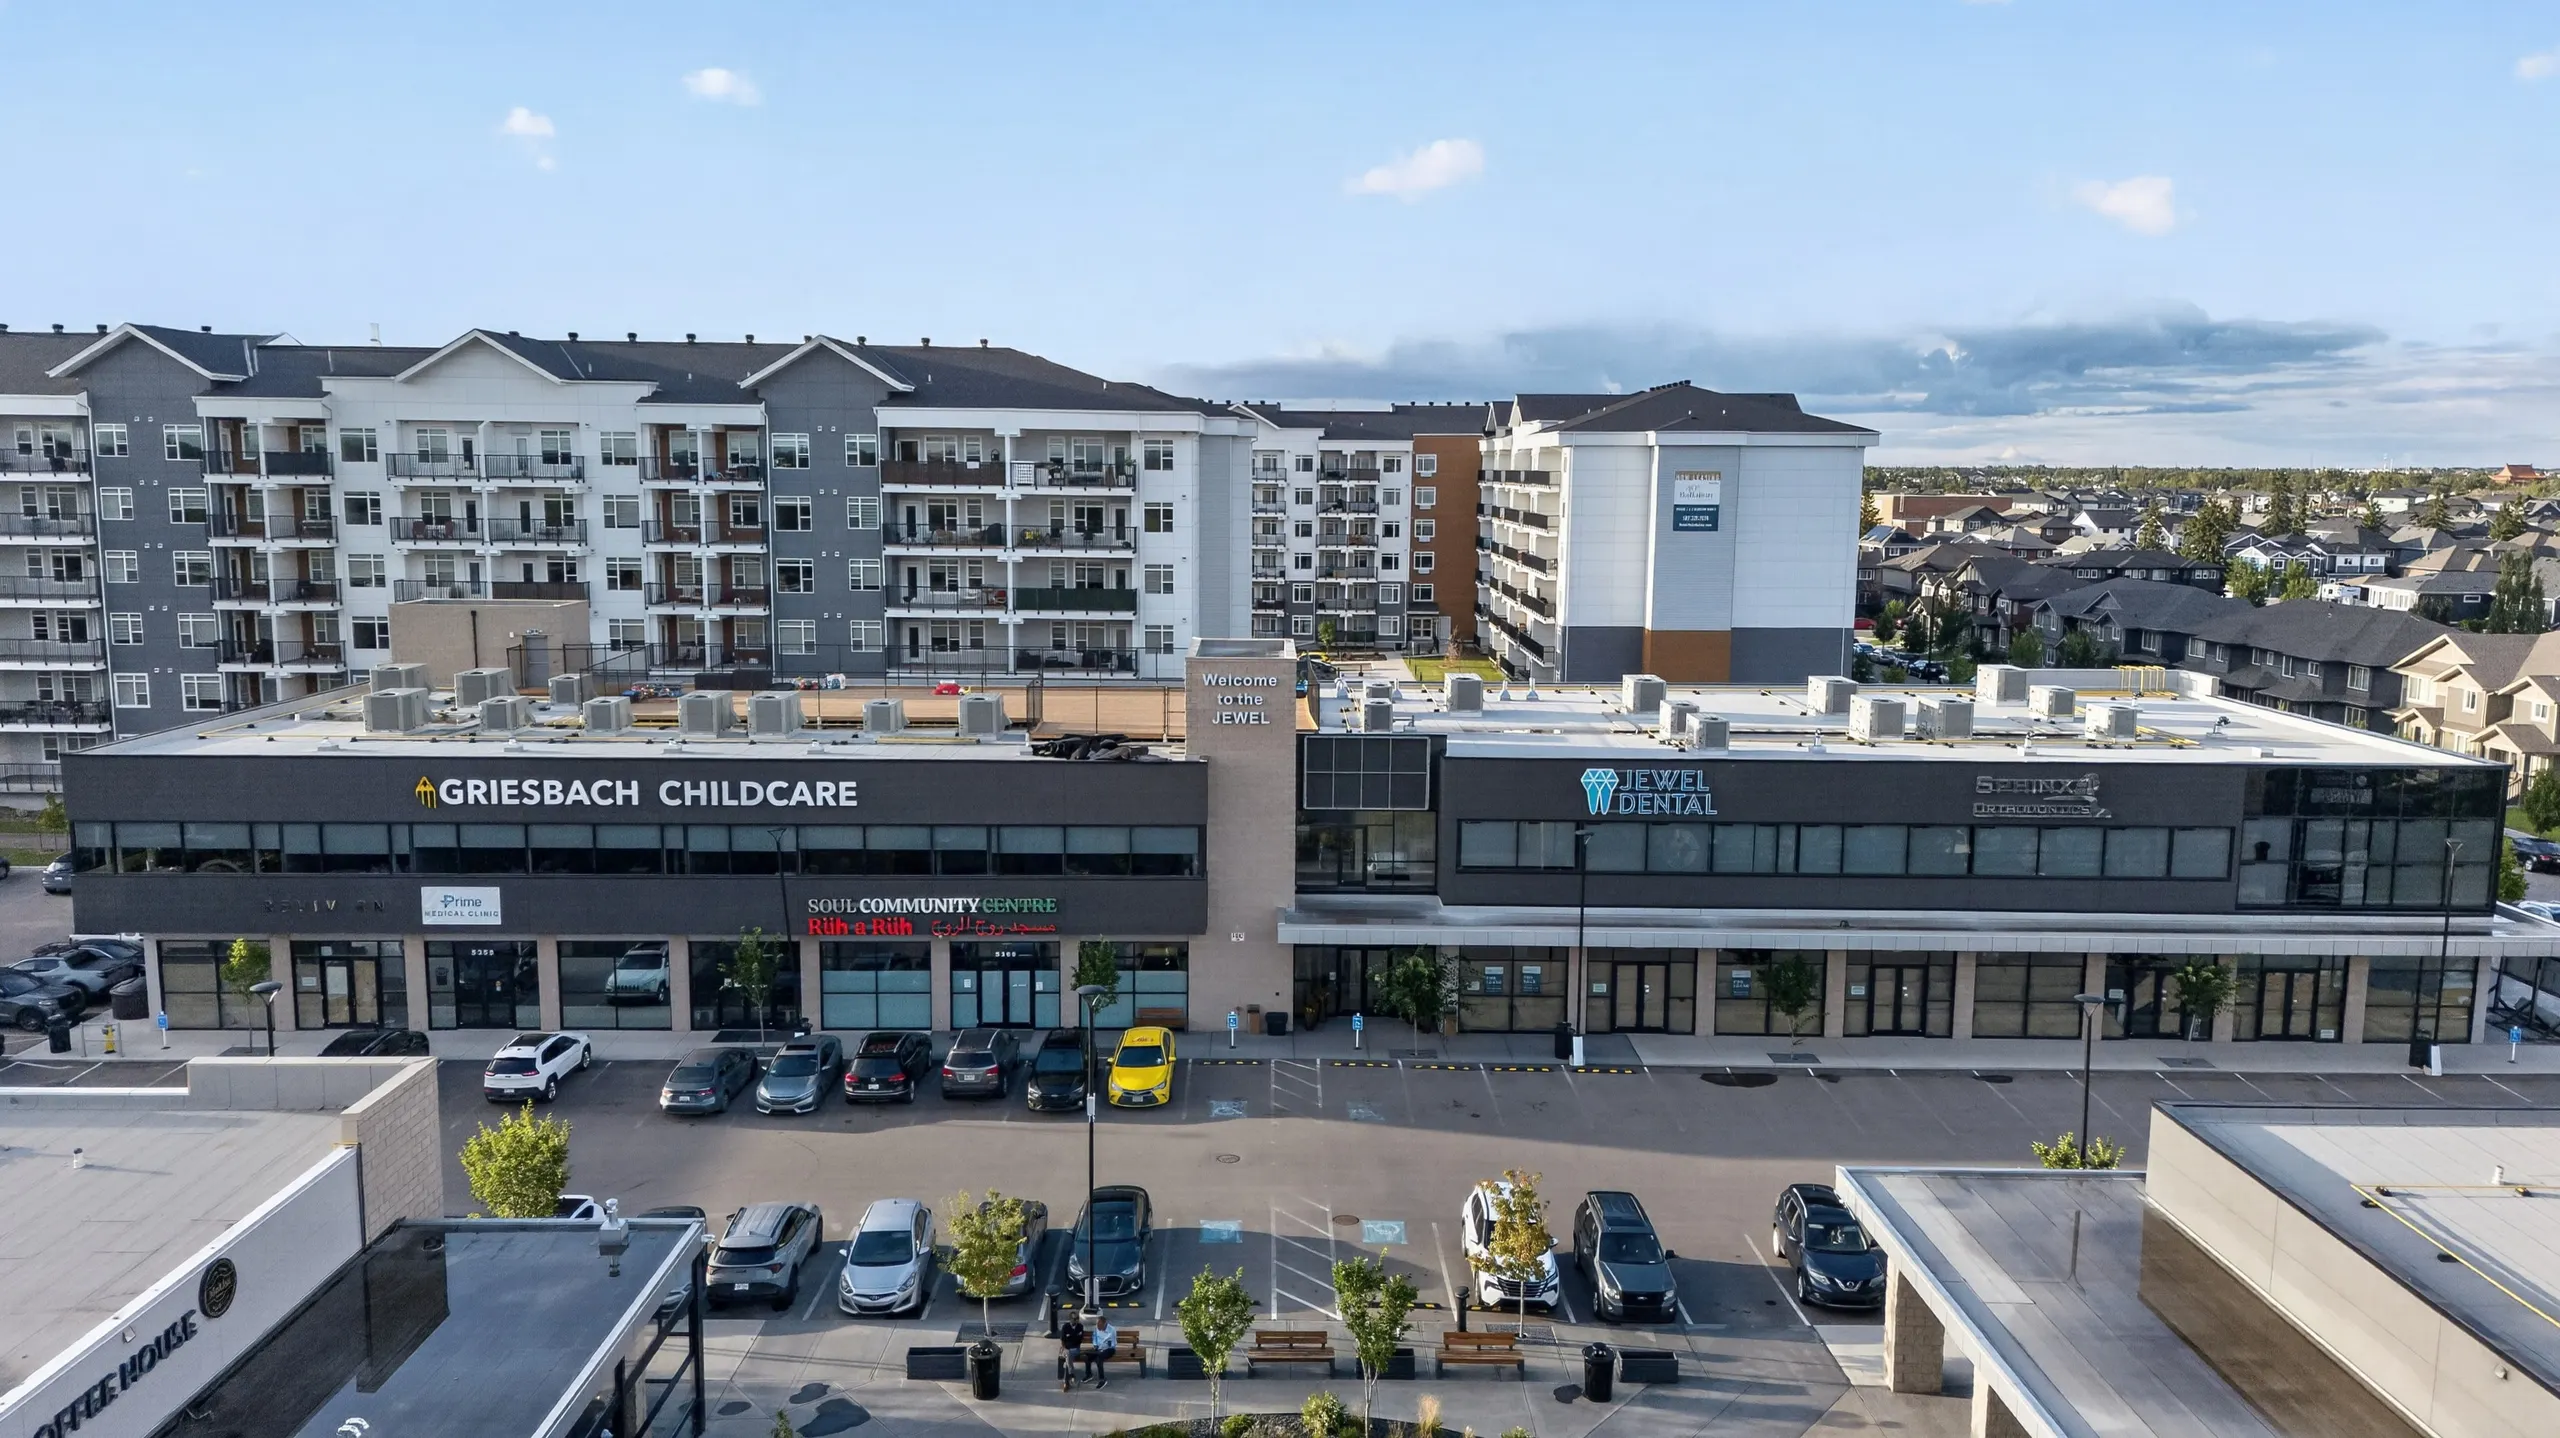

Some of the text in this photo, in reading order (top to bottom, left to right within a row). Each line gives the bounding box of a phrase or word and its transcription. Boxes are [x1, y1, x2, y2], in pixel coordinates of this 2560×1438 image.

[1202, 673, 1277, 687] Welcome
[1217, 692, 1263, 706] to the
[1212, 711, 1271, 725] JEWEL
[1619, 769, 1710, 791] JEWEL
[1975, 776, 2074, 794] SPHINX
[439, 778, 858, 807] GRIESBACH CHILDCARE
[1619, 793, 1718, 815] DENTAL
[440, 894, 482, 909] Prime
[808, 898, 1058, 914] SOUL COMMUNITY CENTRE
[808, 917, 913, 935] Rüh a Rüh
[119, 1309, 198, 1391] HOUSE
